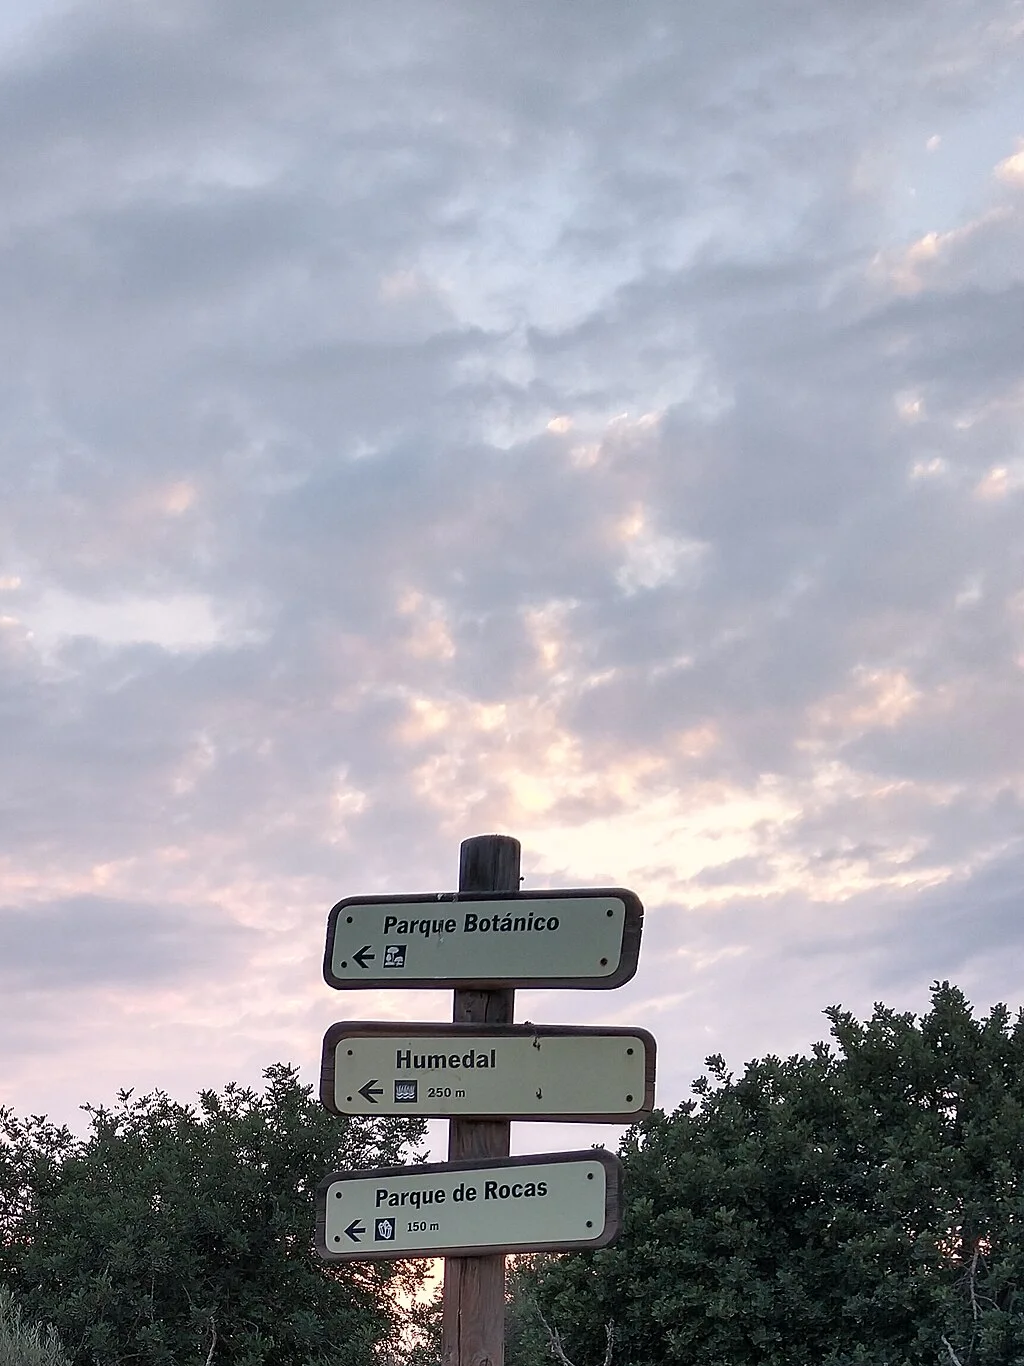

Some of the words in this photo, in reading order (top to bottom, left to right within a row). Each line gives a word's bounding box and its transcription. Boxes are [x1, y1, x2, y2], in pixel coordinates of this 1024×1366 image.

[383, 915, 457, 938] Parque
[464, 911, 560, 932] Botánico
[396, 1049, 495, 1069] Humedal
[427, 1087, 452, 1098] 250
[455, 1089, 466, 1098] m
[375, 1188, 446, 1210] Parque
[452, 1183, 477, 1203] de
[484, 1180, 548, 1200] Rocas
[407, 1221, 427, 1232] 150
[429, 1222, 439, 1231] m
